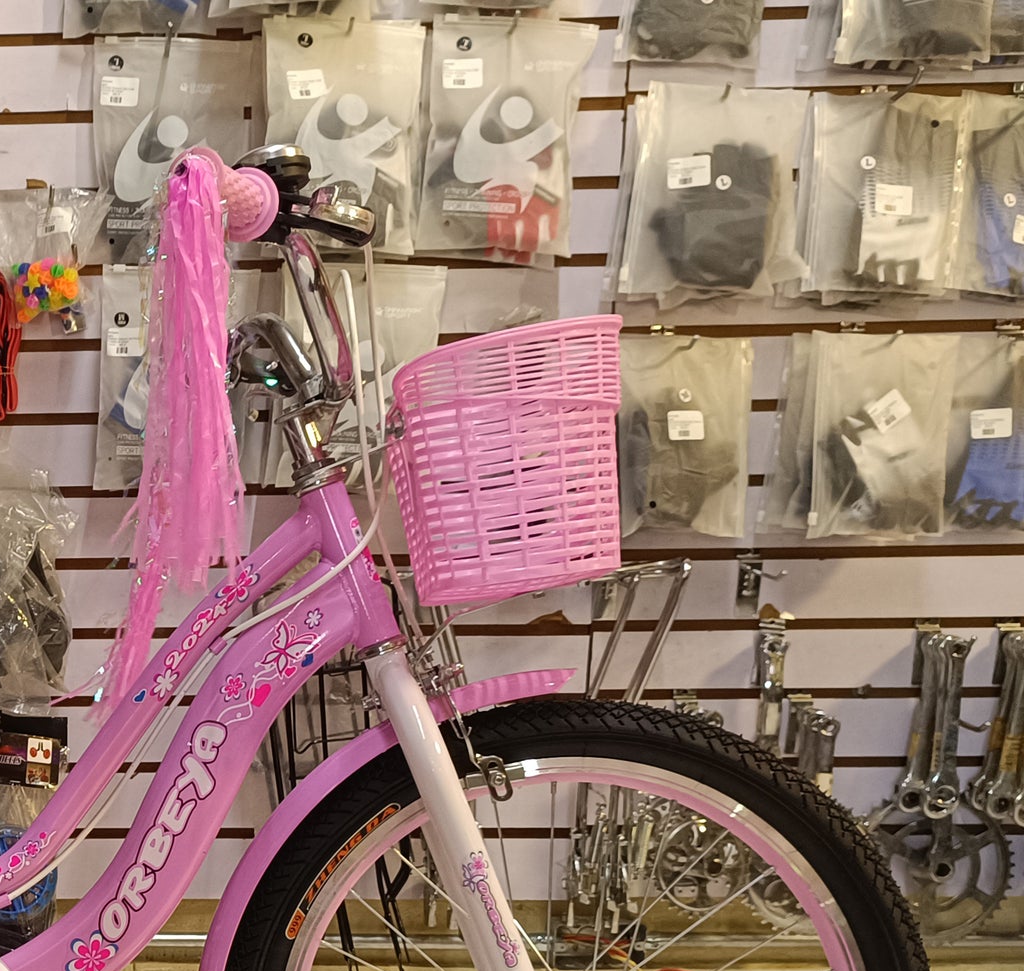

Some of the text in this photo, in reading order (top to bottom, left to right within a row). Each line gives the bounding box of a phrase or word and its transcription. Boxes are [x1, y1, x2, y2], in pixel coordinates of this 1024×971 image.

[98, 720, 228, 943] ORBEYA
[305, 806, 397, 905] ZHENG DA
